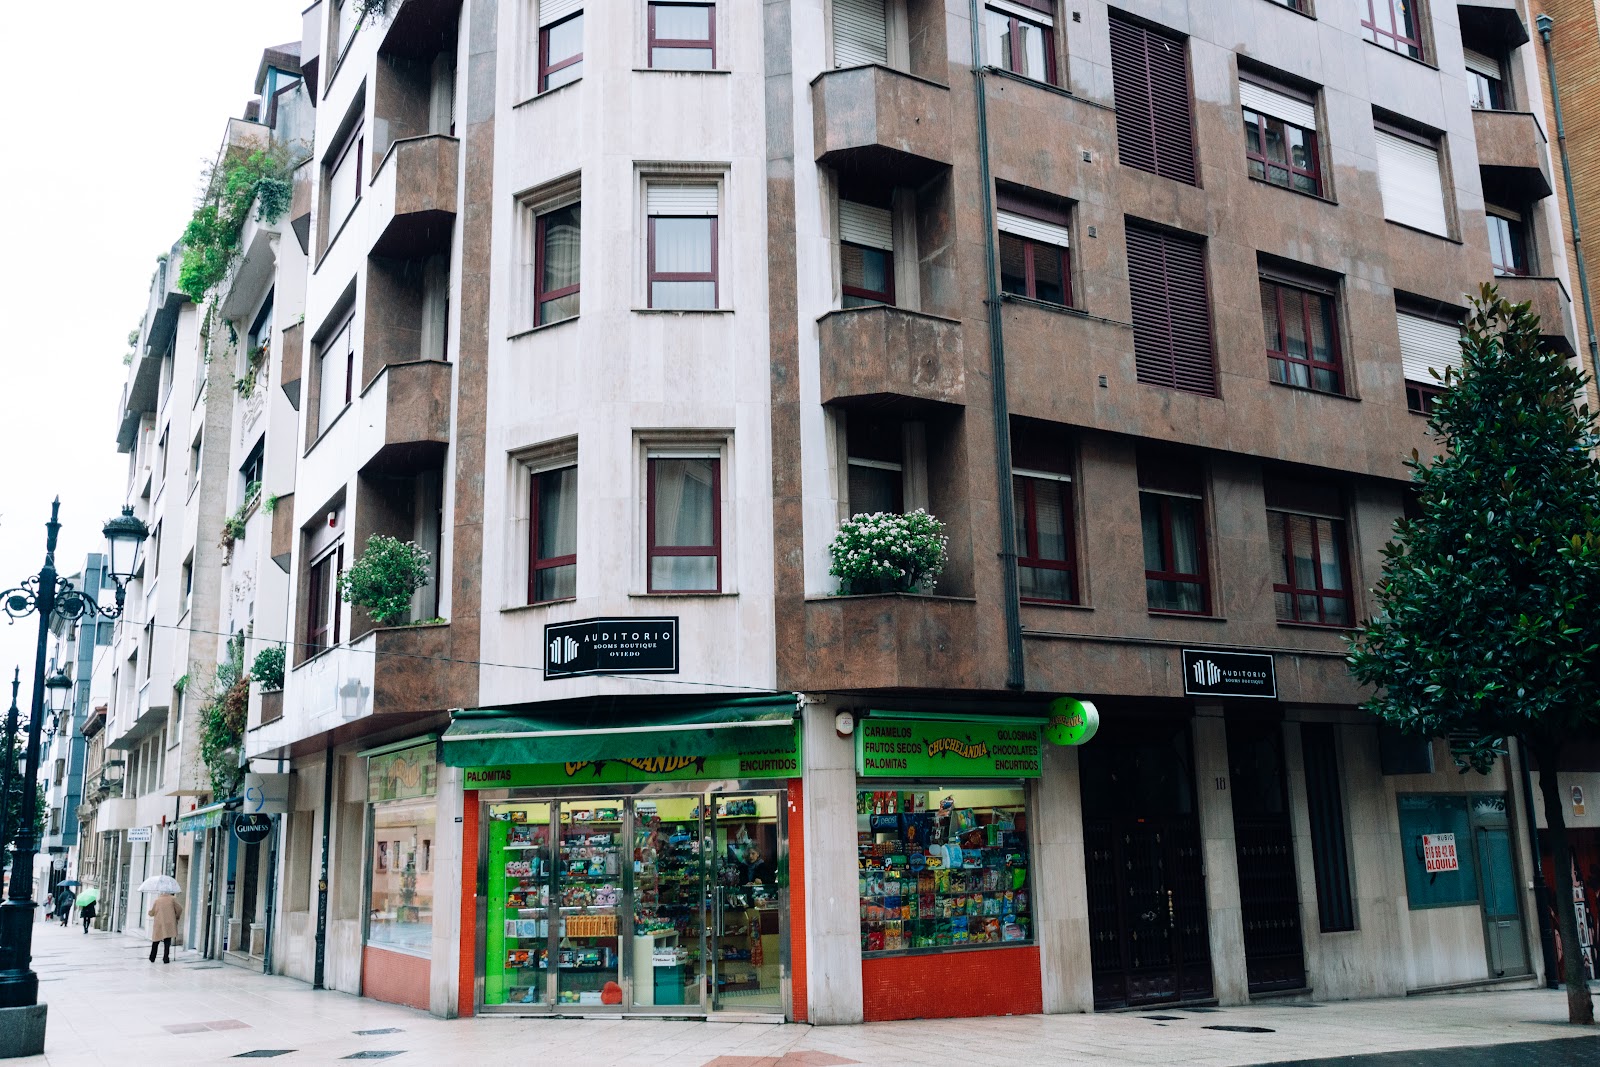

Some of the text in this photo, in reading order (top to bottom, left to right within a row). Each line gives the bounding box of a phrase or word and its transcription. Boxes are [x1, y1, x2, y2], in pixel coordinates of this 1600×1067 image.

[584, 632, 670, 642] AUDITORIO
[1222, 670, 1267, 678] AUDITORIO
[864, 726, 912, 738] CARAMELOS
[997, 730, 1037, 741] GOLOSINAS
[865, 742, 922, 754] FRUTOS SECOS
[928, 738, 988, 758] CHUCHELANDIA
[992, 745, 1038, 756] CHOCOLATES
[740, 758, 797, 771] ENCURTIDOS
[865, 758, 908, 769] PALOMITAS
[995, 760, 1039, 771] ENCURTIDOS
[467, 770, 512, 782] PALOMITAS
[237, 824, 269, 833] GUINNESS
[1427, 858, 1457, 870] ALQUILA
